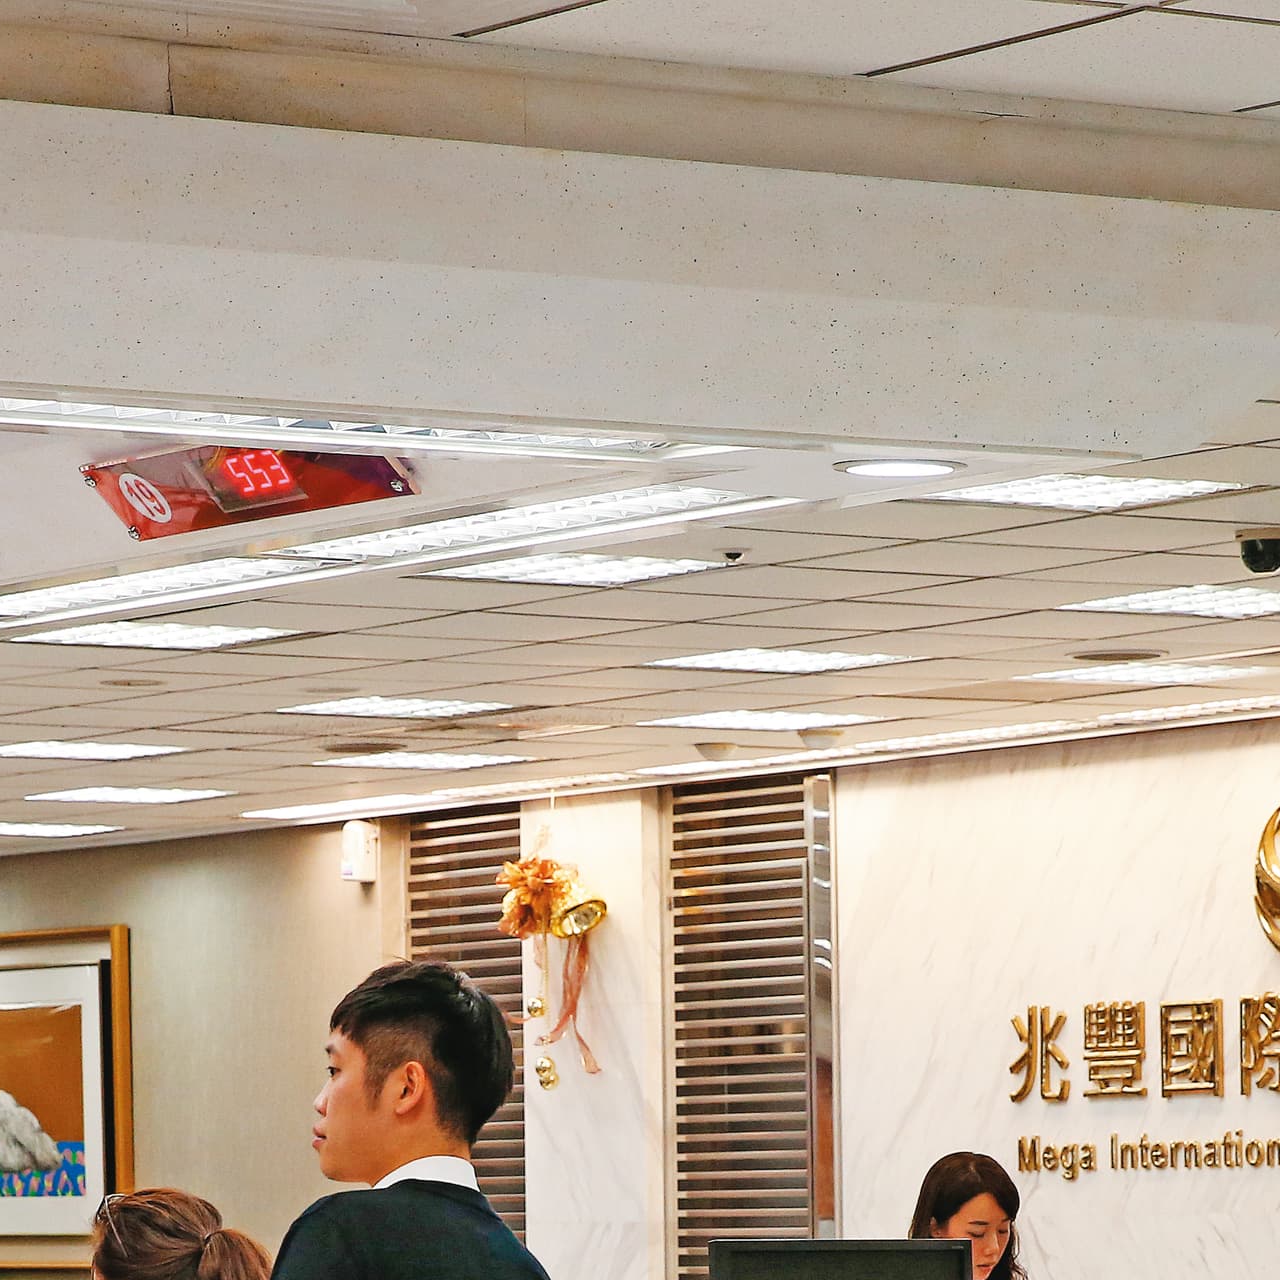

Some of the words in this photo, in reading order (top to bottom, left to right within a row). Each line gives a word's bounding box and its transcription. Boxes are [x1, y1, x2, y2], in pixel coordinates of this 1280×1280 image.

[225, 449, 291, 493] 553
[124, 478, 167, 517] 19
[1018, 1134, 1096, 1180] Mega
